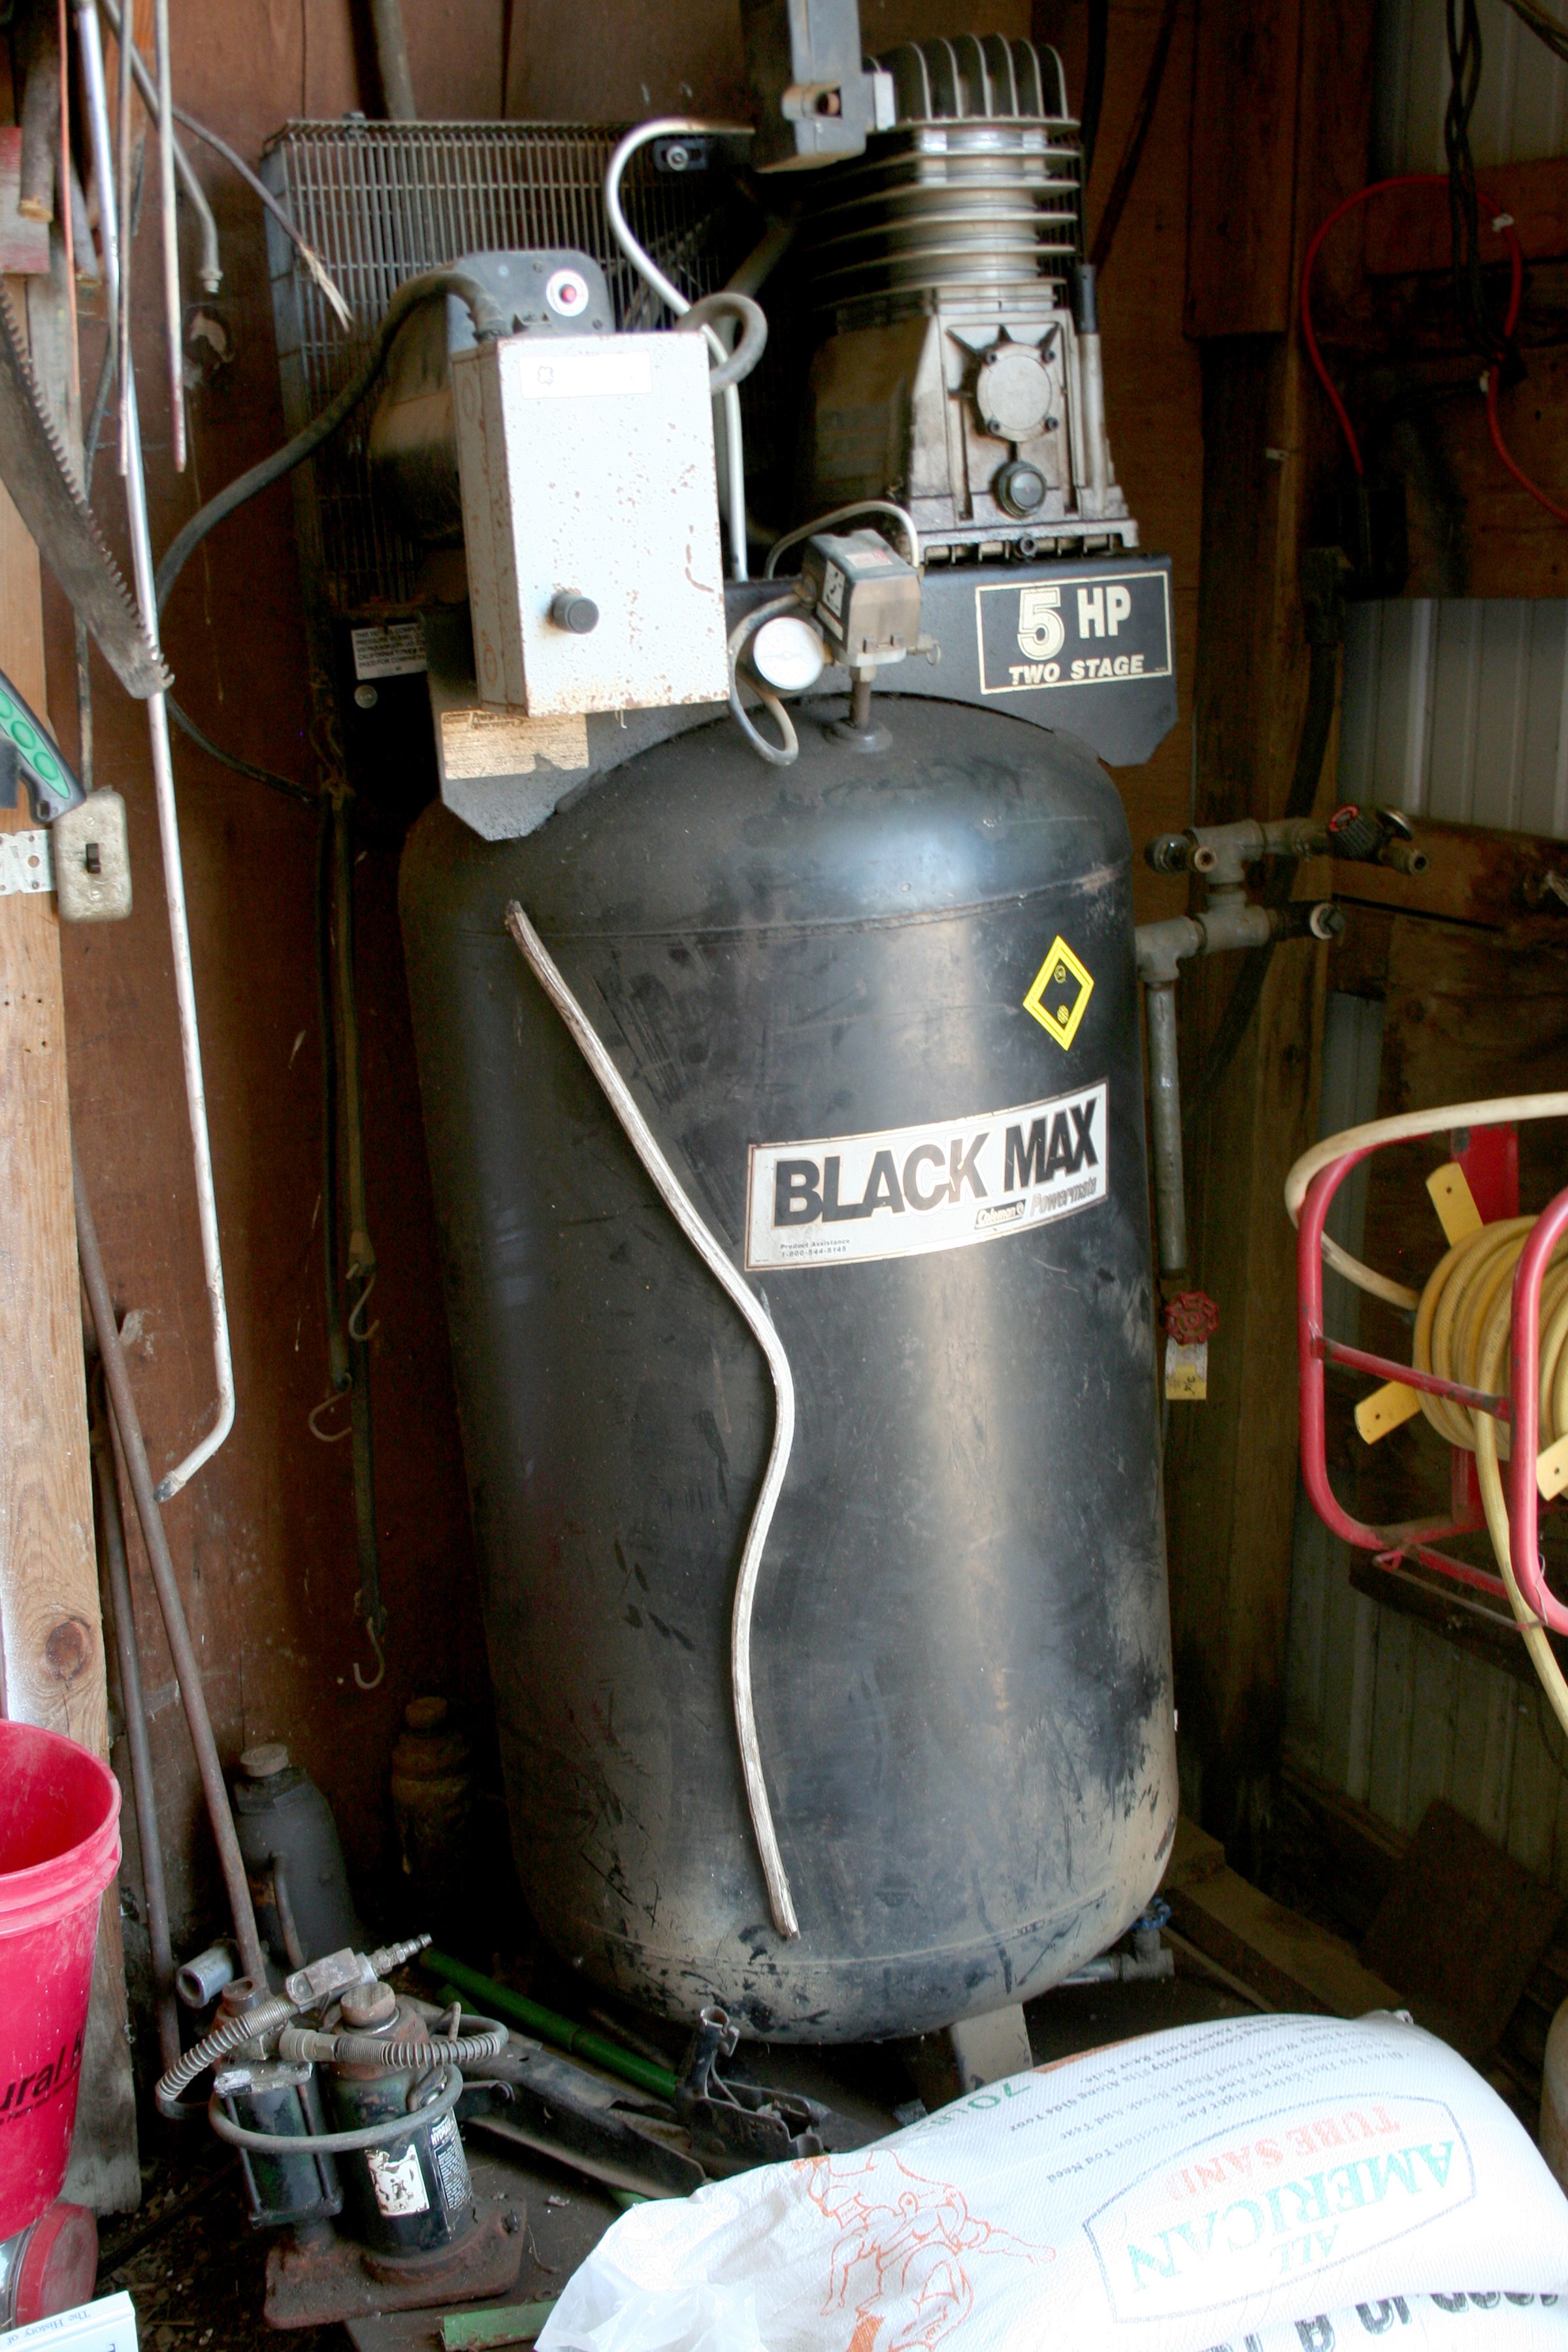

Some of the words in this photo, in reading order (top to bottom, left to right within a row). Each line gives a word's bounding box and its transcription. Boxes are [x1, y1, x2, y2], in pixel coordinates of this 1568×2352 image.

[1017, 587, 1065, 661] 5
[1077, 585, 1131, 639] HP
[1009, 662, 1060, 685] TWO
[1071, 655, 1145, 680] STAGE
[774, 1134, 988, 1227] BLACK
[1004, 1098, 1099, 1192] MAX
[977, 1206, 1016, 1224] Coleman
[1030, 1177, 1098, 1217] Powermate
[811, 1239, 851, 1247] Assistance
[1286, 2106, 1401, 2156] TUBE
[1166, 2138, 1284, 2200] SAND
[1126, 2140, 1454, 2293] AMERICAN
[1270, 2224, 1340, 2274] ALL
[24, 2319, 64, 2338] History
[68, 2309, 91, 2322] The
[7, 2334, 19, 2346] of
